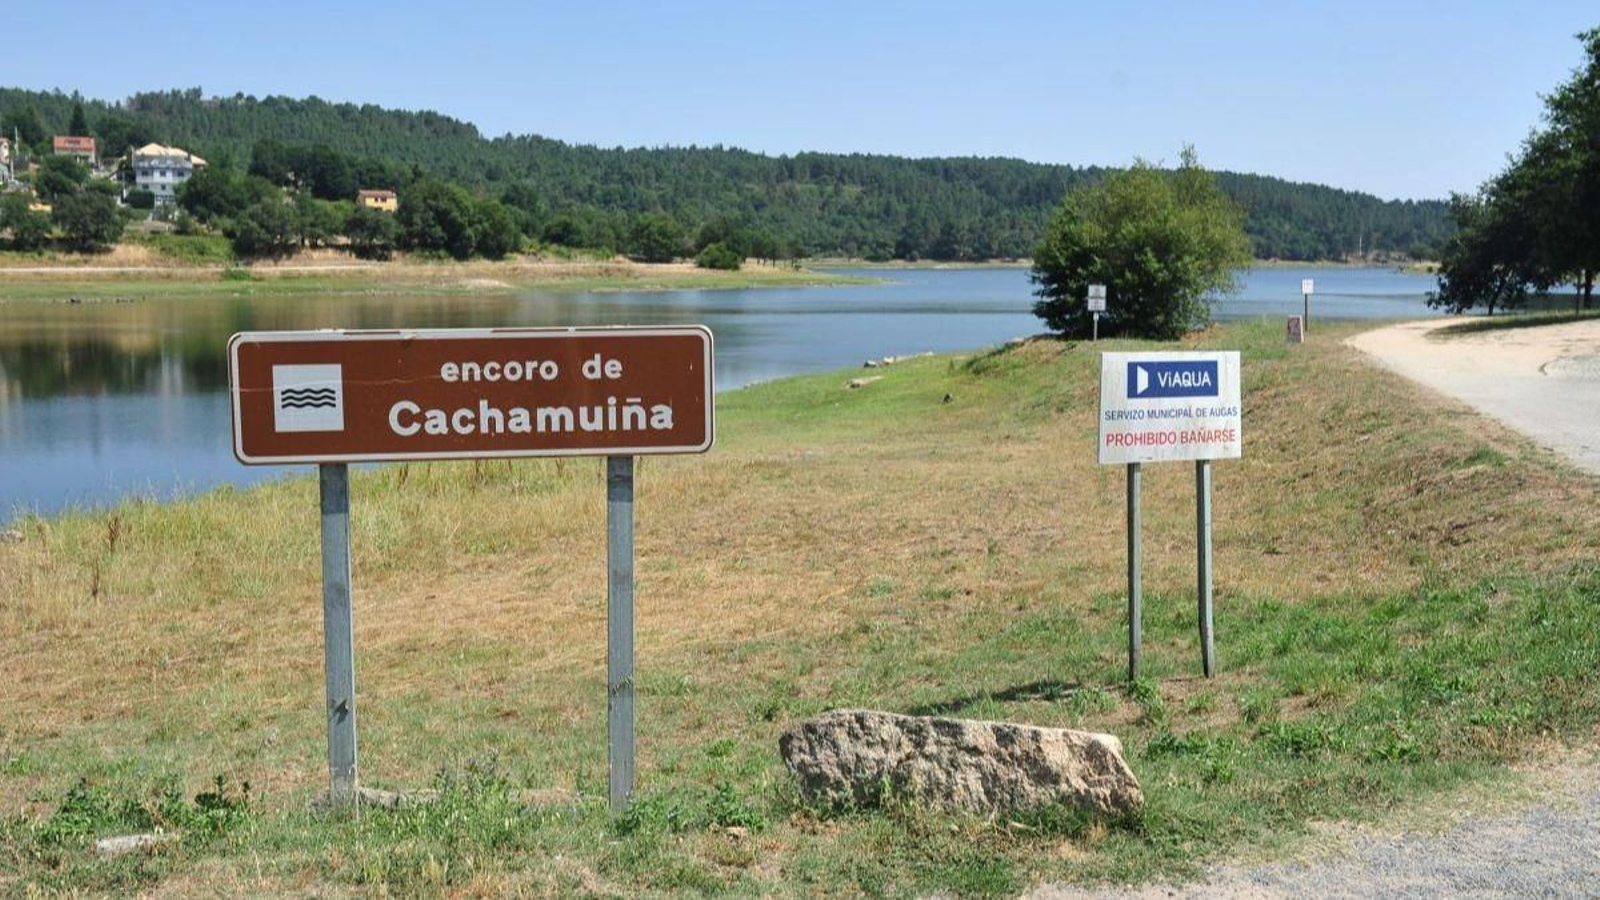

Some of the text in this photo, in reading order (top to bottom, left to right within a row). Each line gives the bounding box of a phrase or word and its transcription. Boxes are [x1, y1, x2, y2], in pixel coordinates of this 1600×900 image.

[441, 353, 623, 382] encoro de
[388, 397, 674, 436] Cachamuiña
[1104, 405, 1238, 421] SERVIZO MUNICIPAL DE AUGAS
[1106, 426, 1236, 447] PROHIBIDO BAÑARSE
